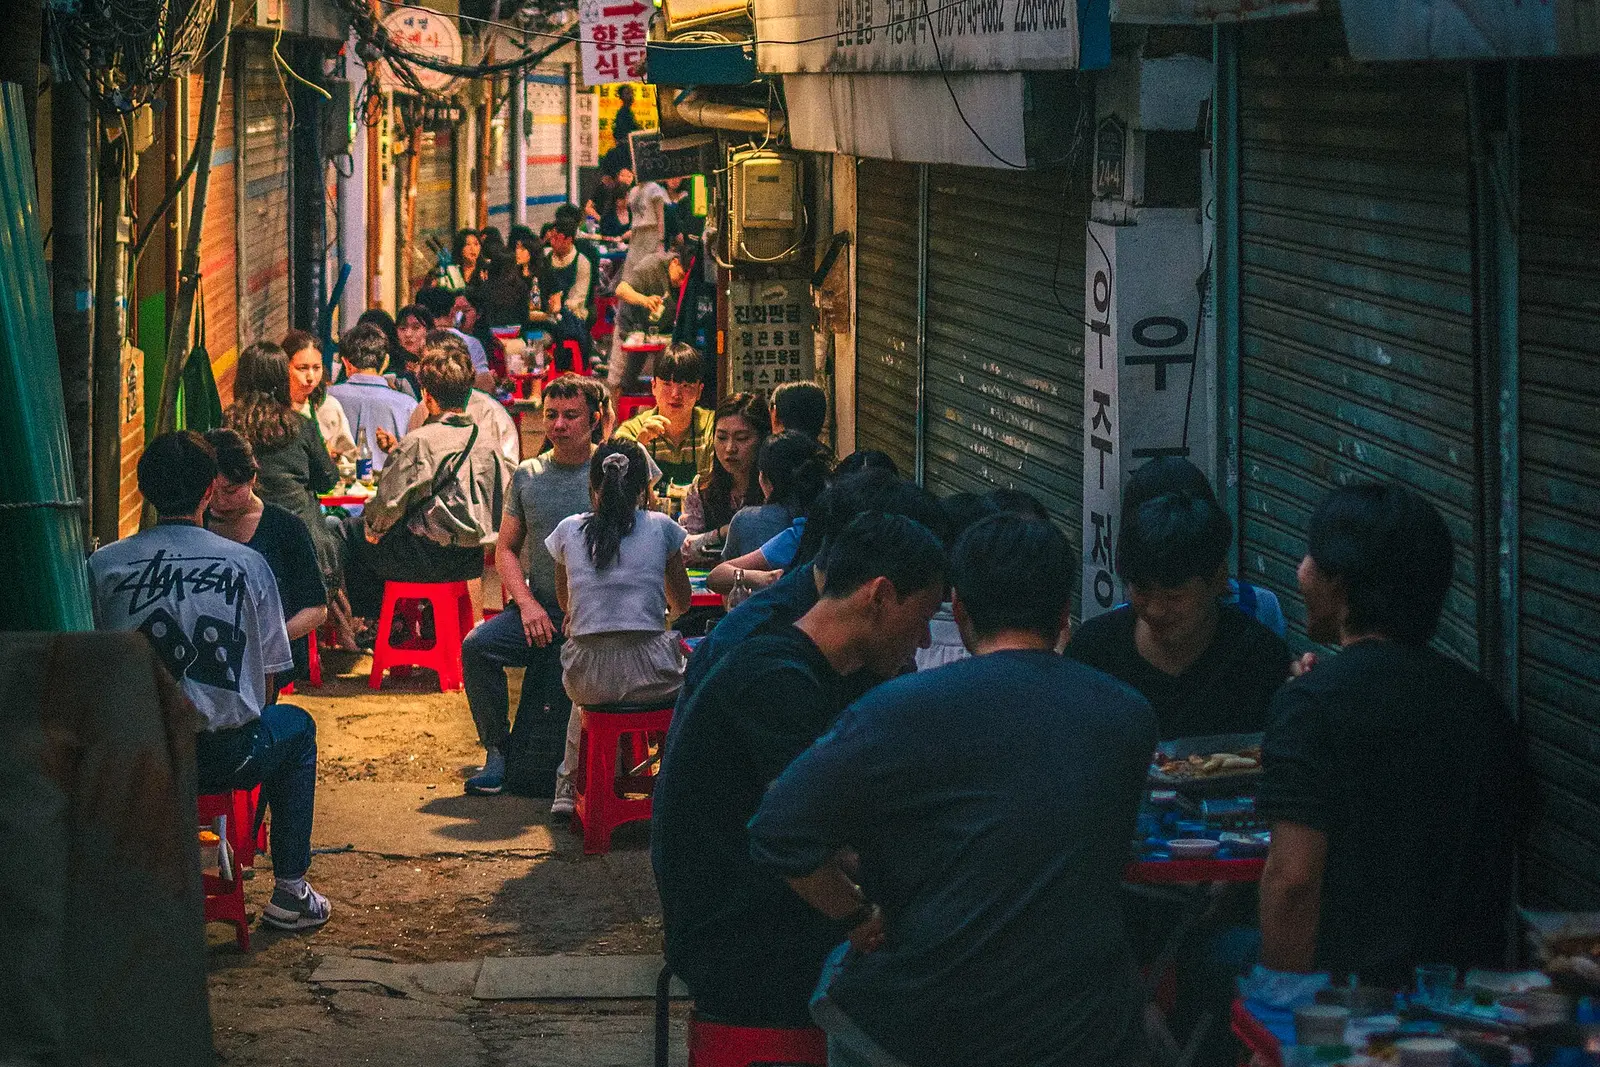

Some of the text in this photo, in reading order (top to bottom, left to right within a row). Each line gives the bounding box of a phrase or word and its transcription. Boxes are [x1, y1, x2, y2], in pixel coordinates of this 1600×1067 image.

[592, 21, 646, 51] 향촌
[595, 50, 647, 79] 식당
[1098, 160, 1120, 188] 24-4
